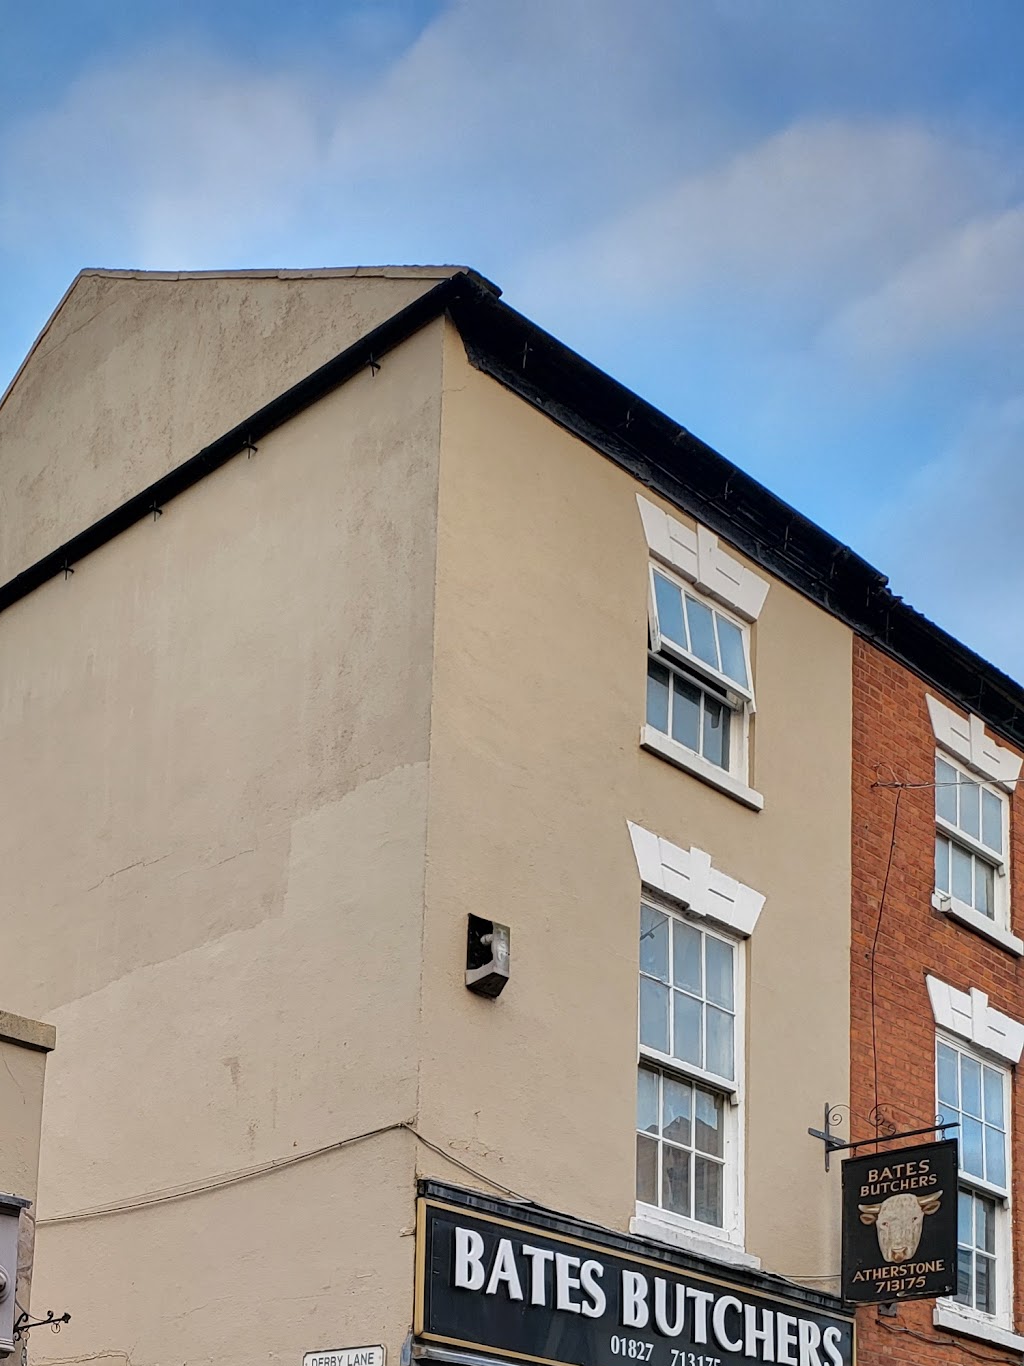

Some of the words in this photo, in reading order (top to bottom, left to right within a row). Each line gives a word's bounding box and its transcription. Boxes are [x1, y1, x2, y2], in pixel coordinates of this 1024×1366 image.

[868, 1159, 931, 1183] BATES
[860, 1173, 938, 1197] BUTCHERS
[455, 1226, 606, 1319] BATES
[852, 1259, 946, 1283] ATHERSTONE
[876, 1275, 926, 1294] 713175
[610, 1335, 655, 1362] 01827
